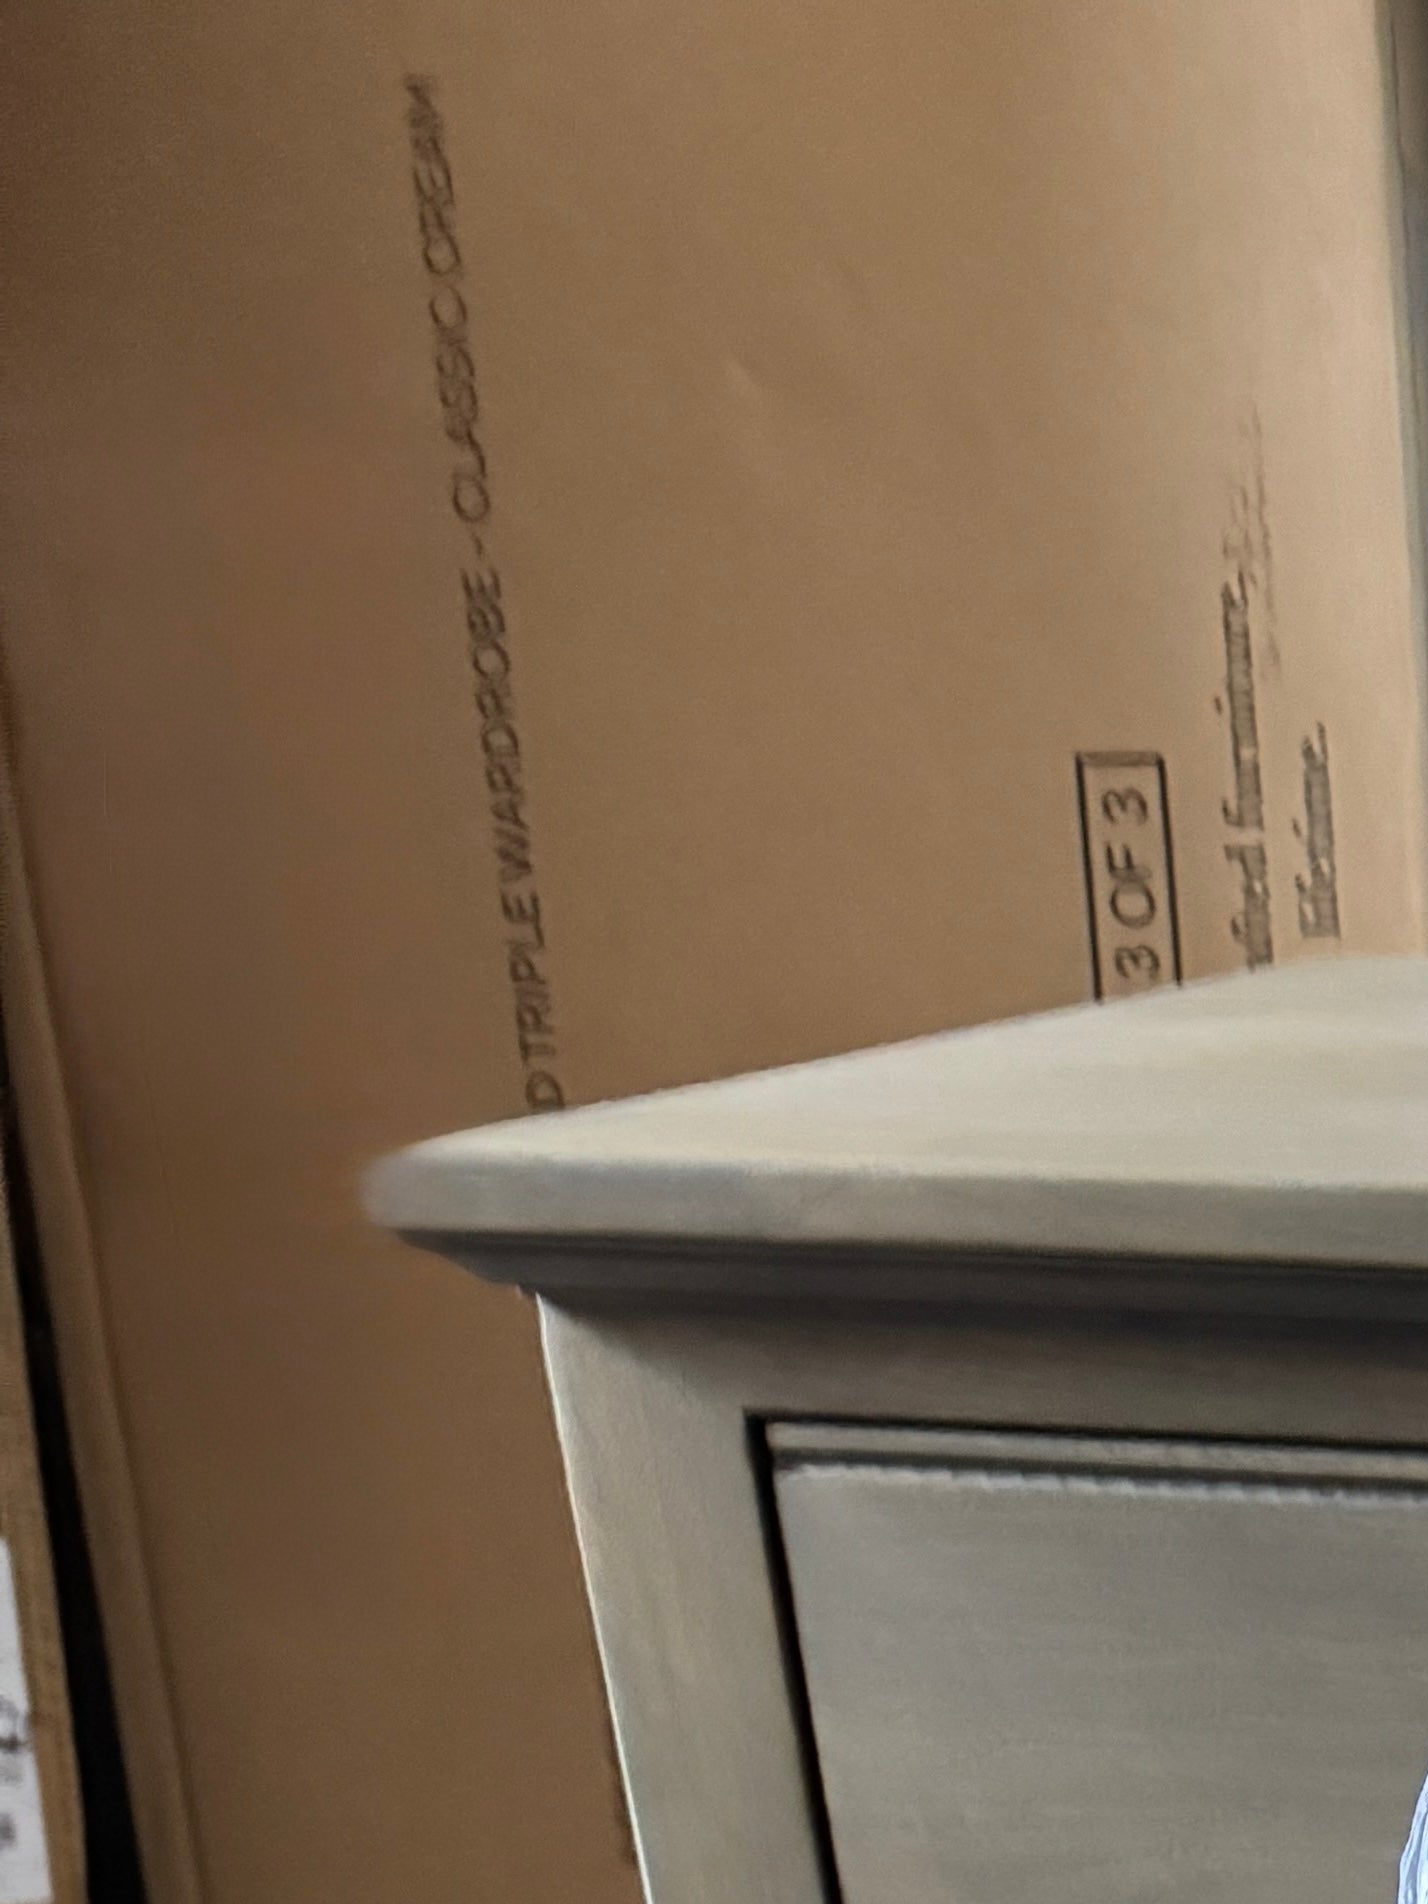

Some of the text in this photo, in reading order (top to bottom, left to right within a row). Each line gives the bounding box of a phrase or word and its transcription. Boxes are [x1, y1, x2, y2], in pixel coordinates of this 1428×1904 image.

[405, 76, 462, 276] CREAM
[429, 286, 492, 523] CLASSIC
[462, 570, 533, 883] WARDROBE
[502, 892, 556, 1064] TRIPLE
[1101, 789, 1158, 980] 3 OF 3
